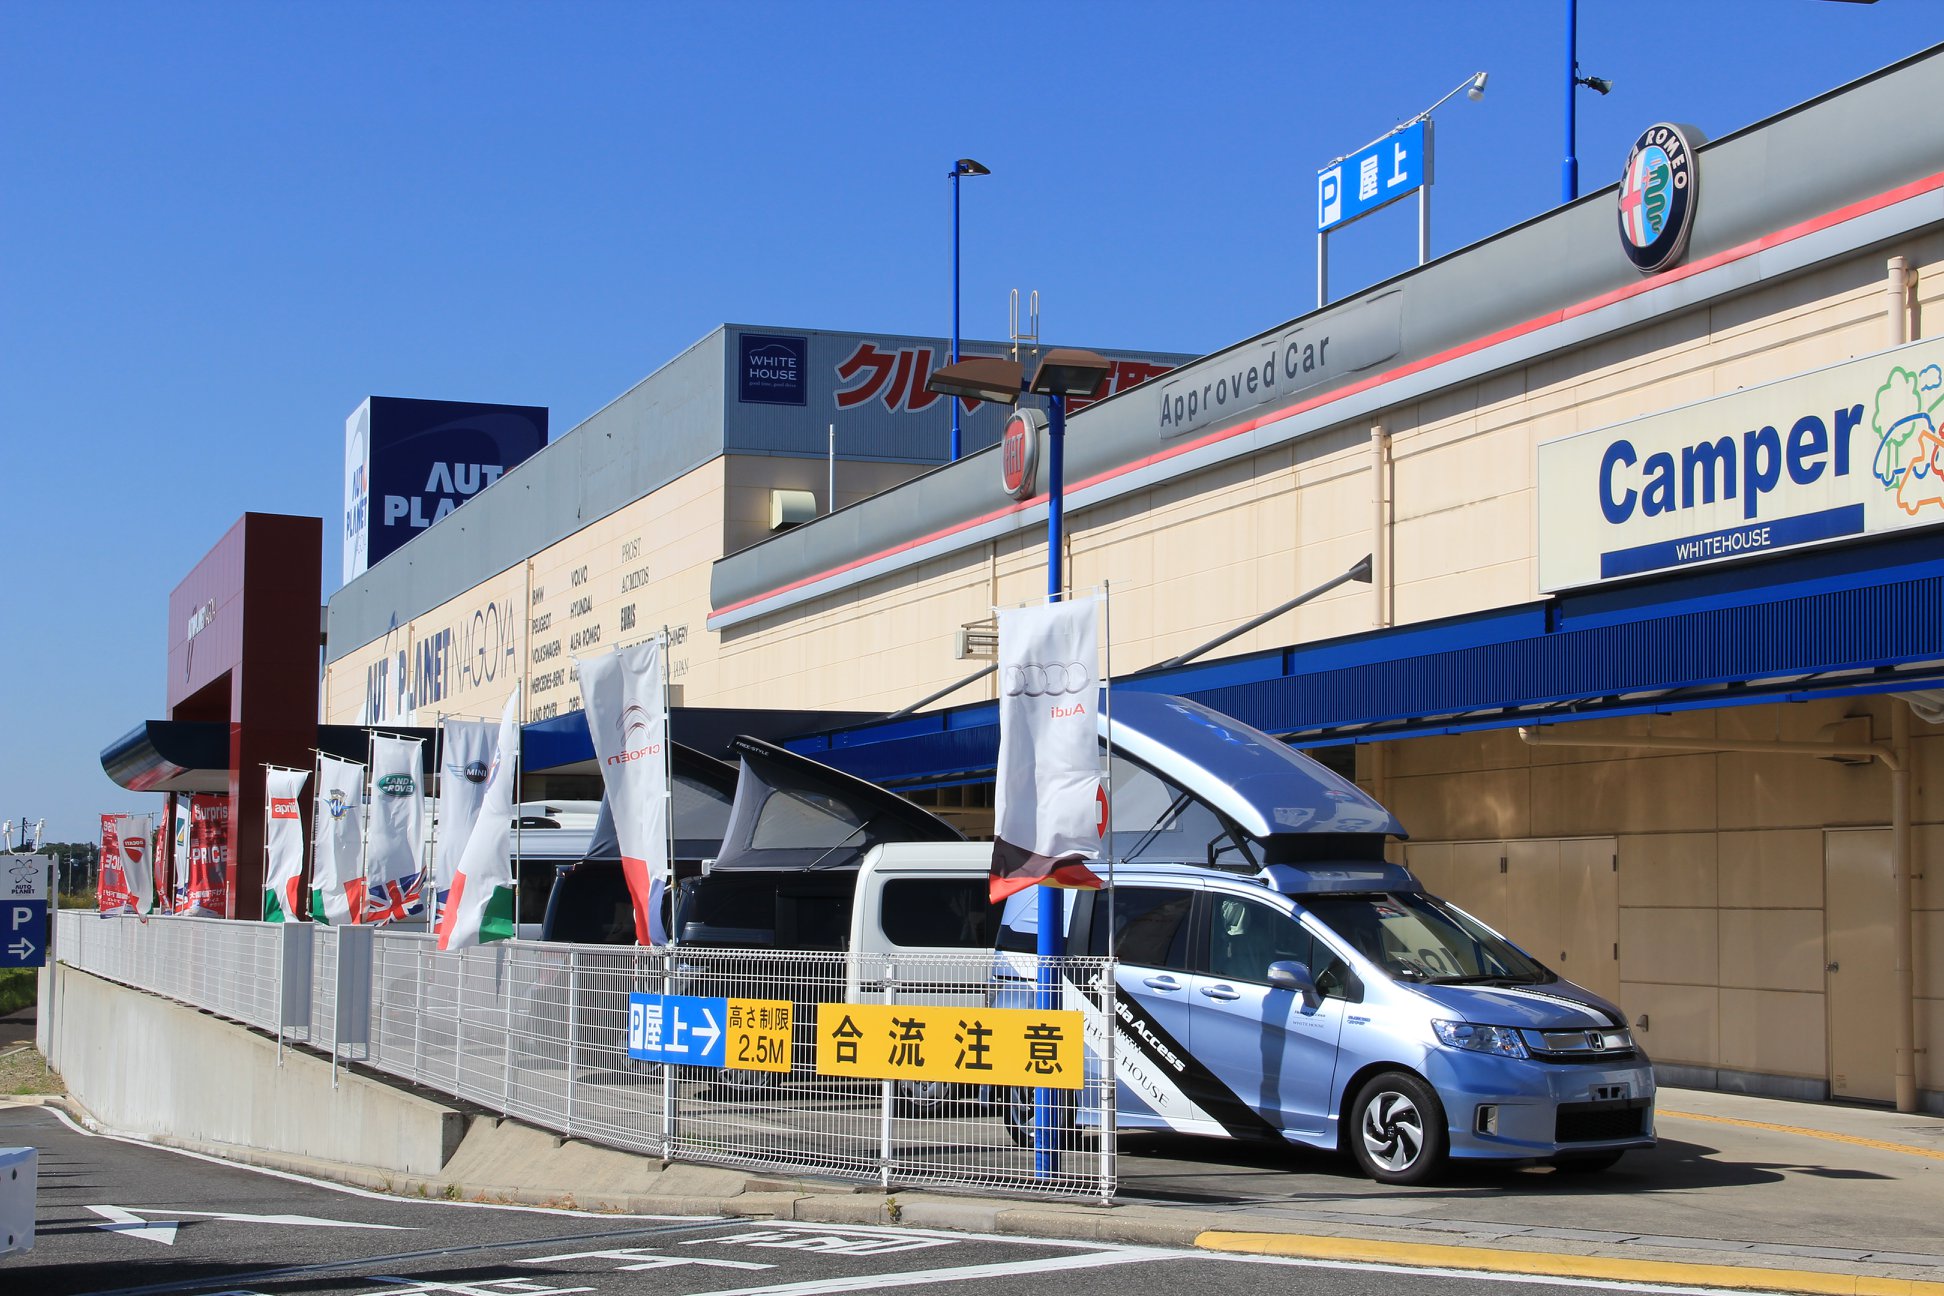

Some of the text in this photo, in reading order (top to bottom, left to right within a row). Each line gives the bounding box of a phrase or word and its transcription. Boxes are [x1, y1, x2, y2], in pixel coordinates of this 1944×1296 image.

[1645, 128, 1688, 189] ROMEO
[1359, 142, 1408, 203] 屋上
[749, 356, 797, 368] WHITE
[749, 368, 797, 381] HOUSE
[1160, 351, 1276, 427] Approved
[1285, 336, 1329, 379] Car
[1599, 403, 1864, 524] Camper
[425, 461, 517, 494] AUT
[384, 494, 470, 528] PLA
[621, 537, 642, 563] PROST
[1676, 527, 1771, 561] WHITEHOUSE
[571, 564, 588, 587] VOLVO
[532, 586, 544, 606] BMW
[570, 595, 593, 619] HYUNDAI
[532, 612, 551, 635] PEUGEOT
[451, 598, 516, 697] NAGOYA
[532, 639, 562, 664] VOLKSWAGEN
[570, 632, 582, 652] ALFA
[582, 624, 601, 647] ROMEO
[531, 668, 565, 695] MERCEDES-BENZ
[543, 701, 558, 720] ROVER
[385, 777, 410, 786] LAND
[466, 769, 487, 777] MINI
[194, 804, 229, 821] Surpris
[12, 907, 33, 931] P
[644, 1004, 689, 1053] 屋上
[729, 1005, 789, 1031] 高さ制限
[738, 1034, 784, 1064] 2.5M
[831, 1015, 1064, 1074] 合流注意
[1131, 1020, 1186, 1072] Access
[1122, 1056, 1170, 1108] HOUSE
